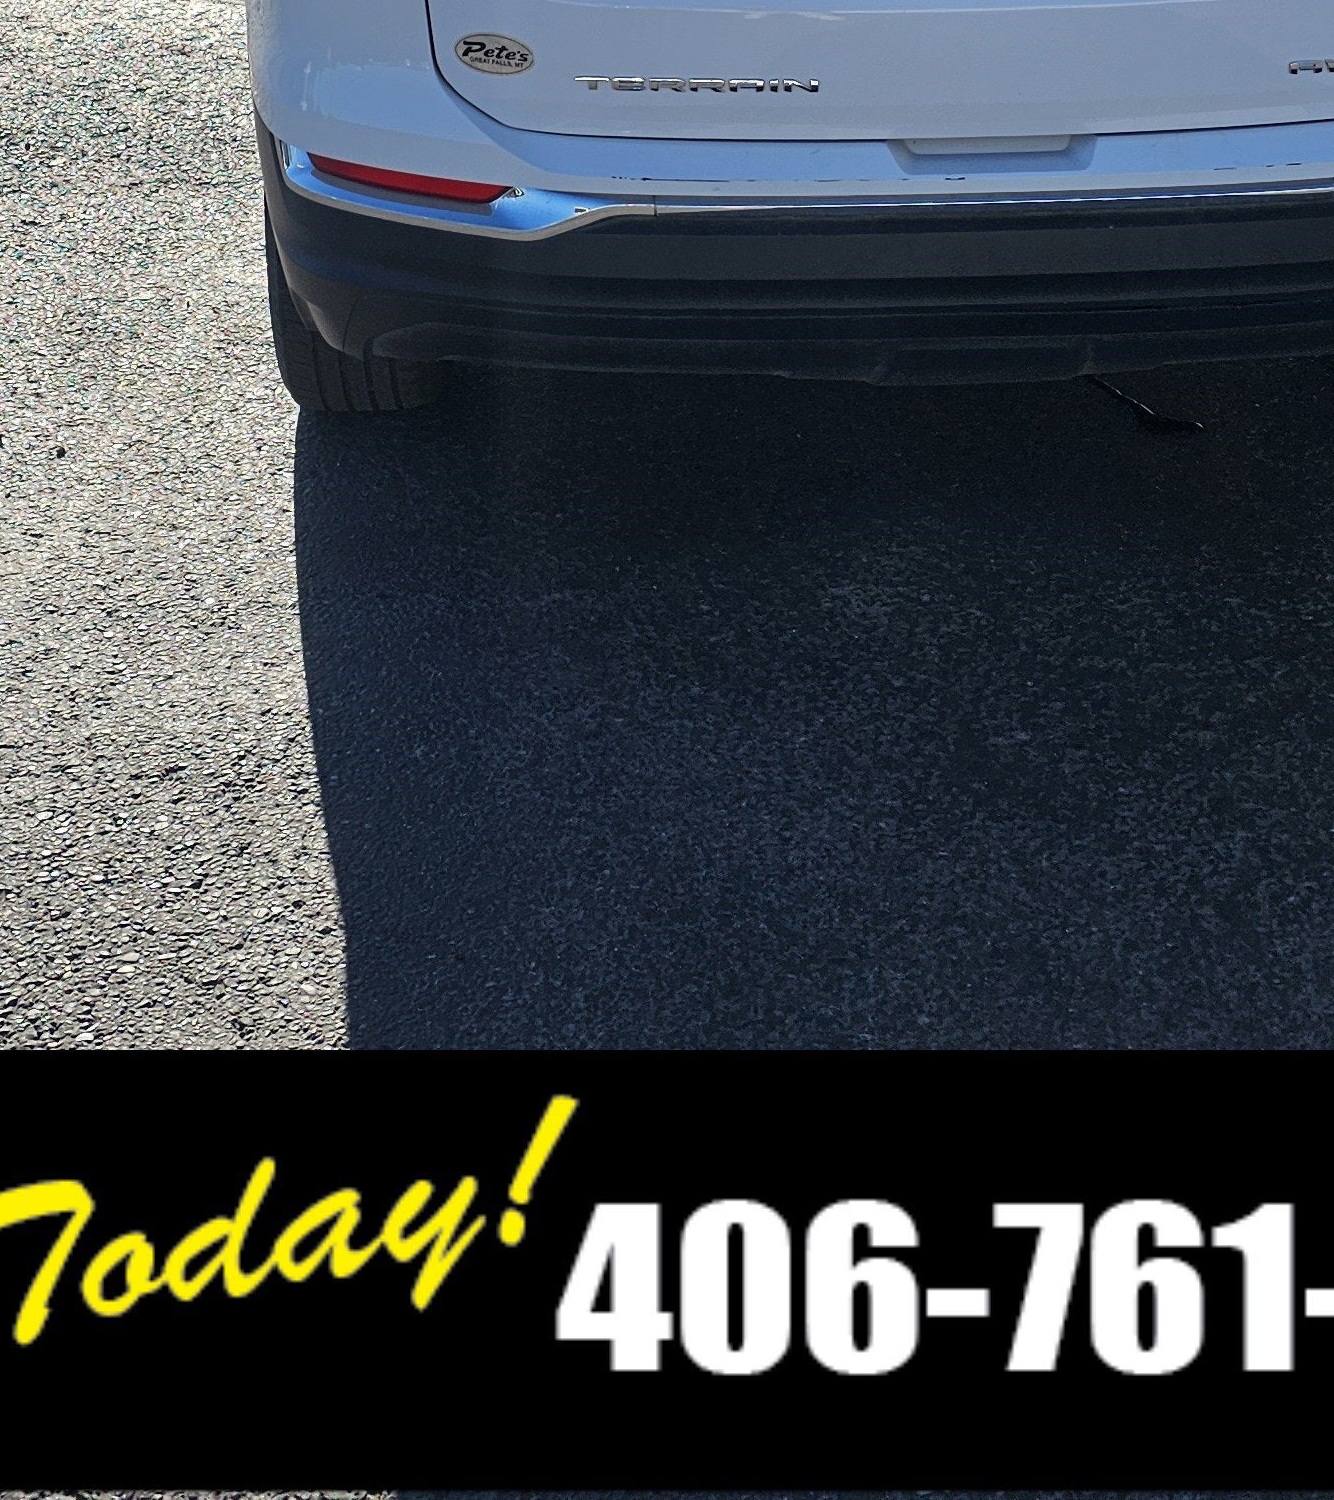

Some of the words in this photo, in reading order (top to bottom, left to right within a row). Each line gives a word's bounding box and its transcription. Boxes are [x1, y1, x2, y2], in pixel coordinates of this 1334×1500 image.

[461, 40, 529, 62] Pete's
[469, 56, 490, 64] GREAT
[573, 75, 819, 93] TERRAIN
